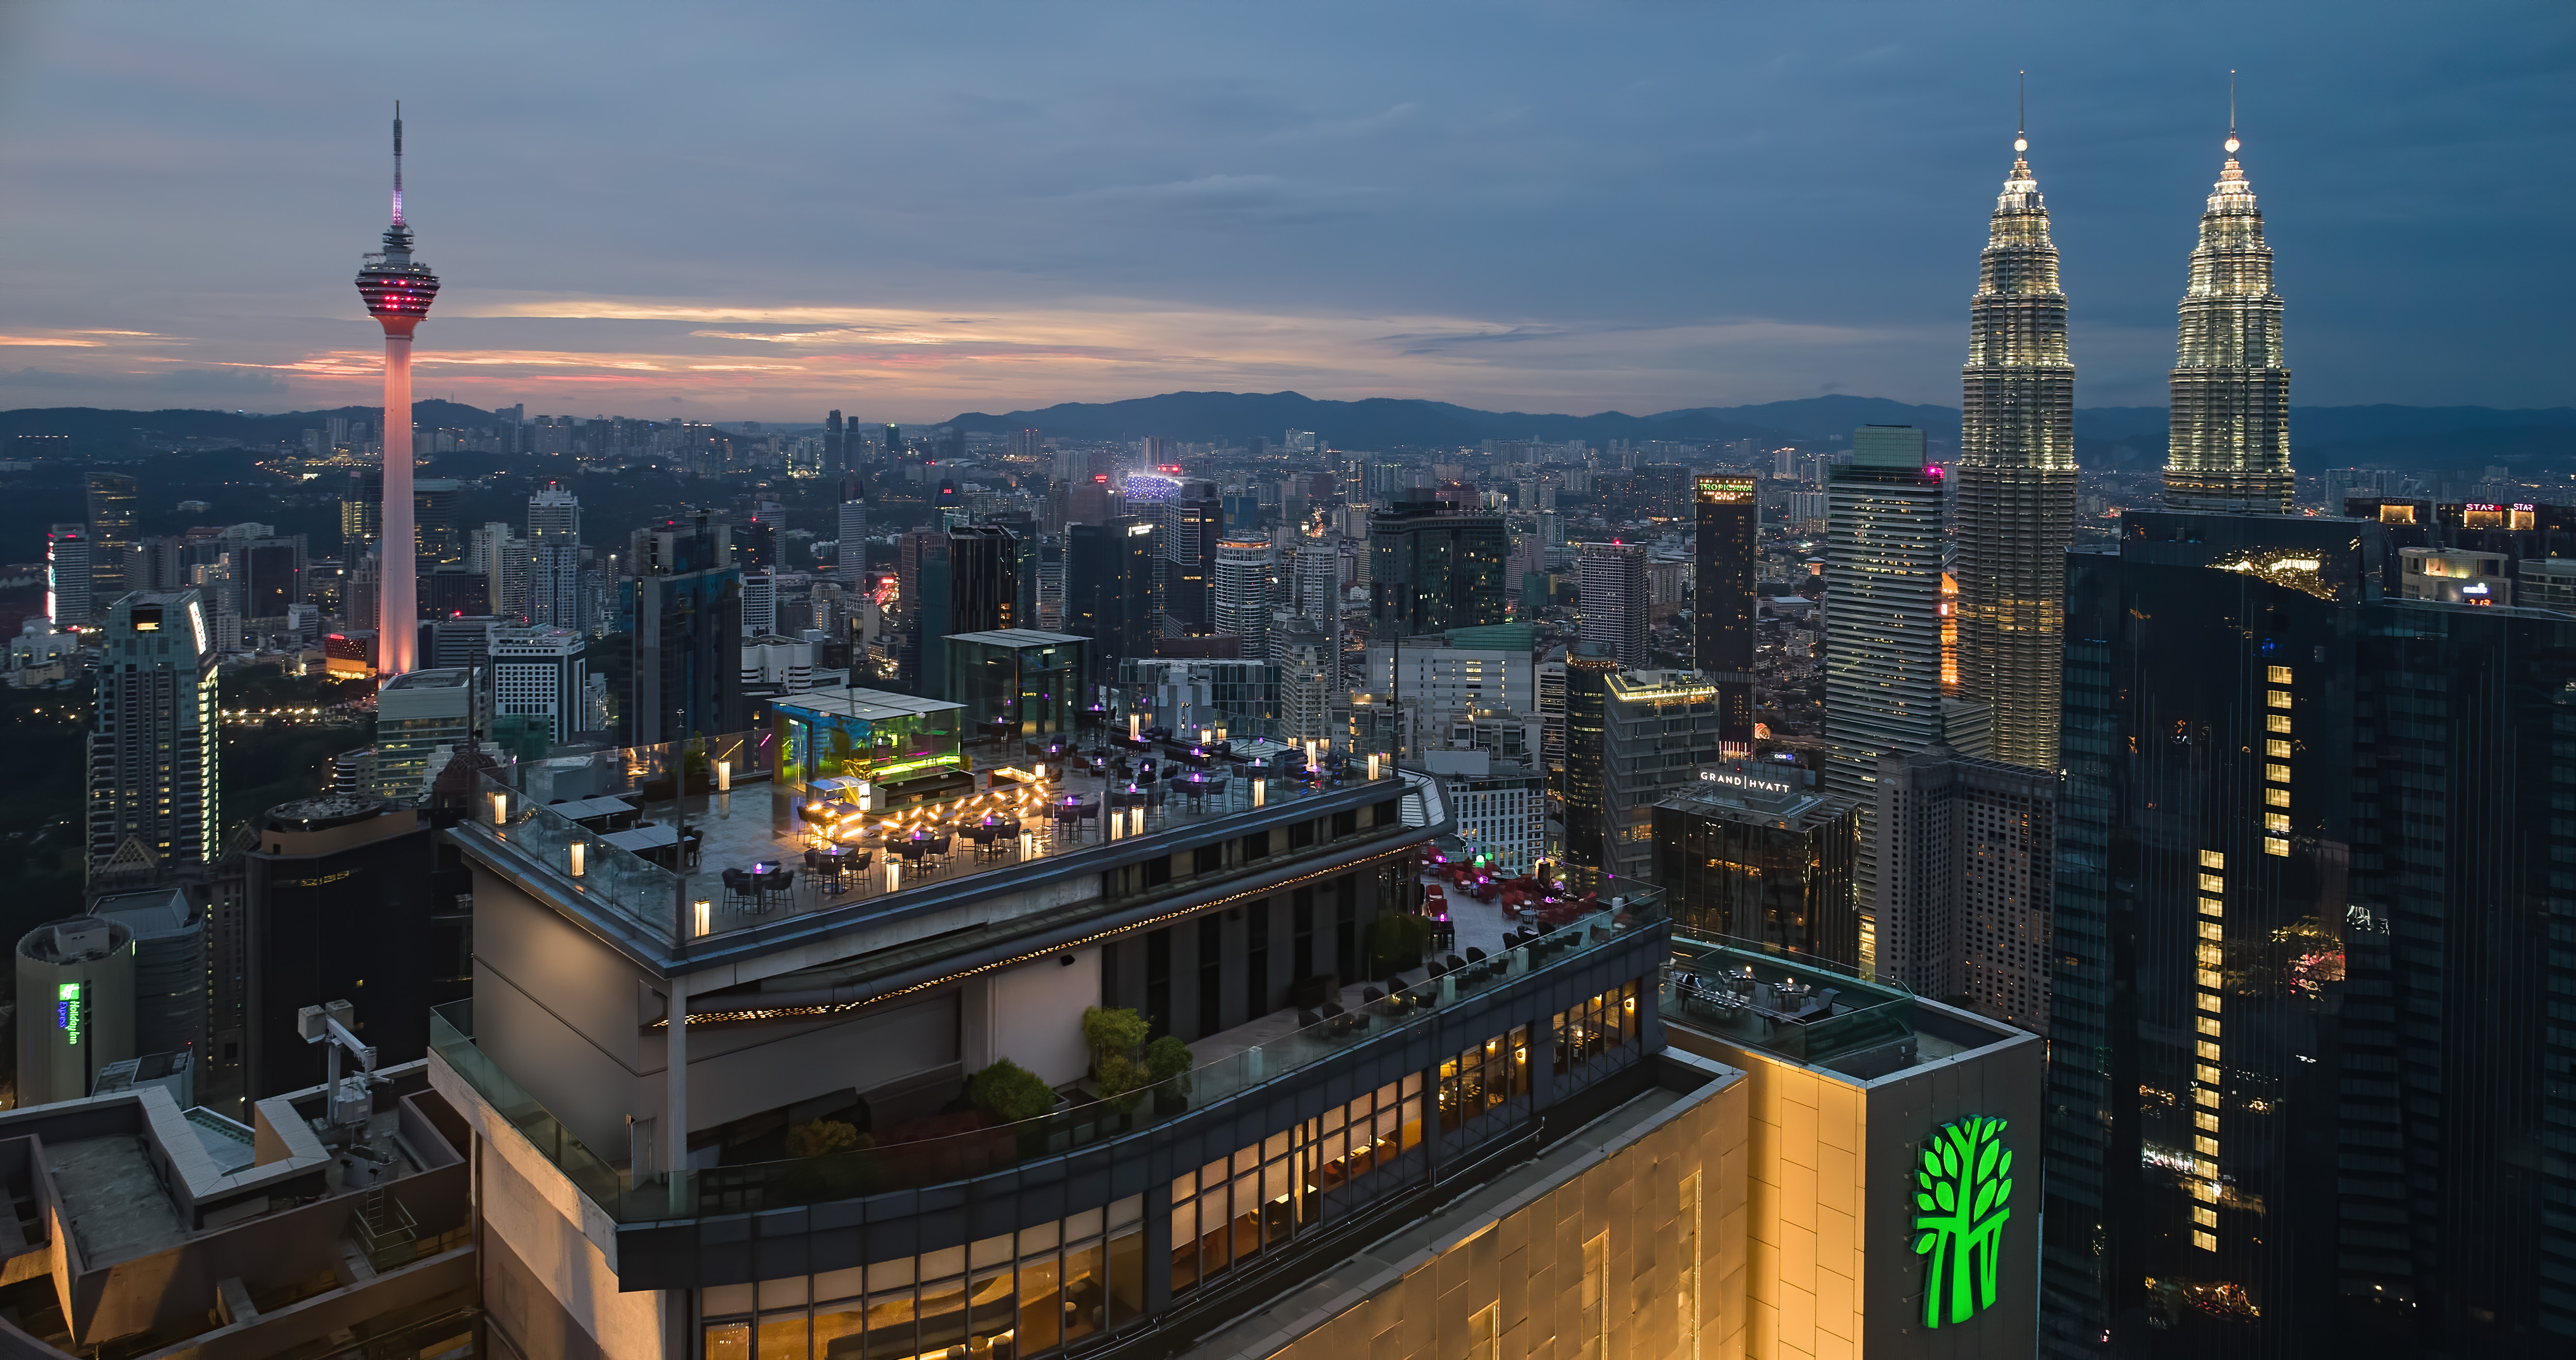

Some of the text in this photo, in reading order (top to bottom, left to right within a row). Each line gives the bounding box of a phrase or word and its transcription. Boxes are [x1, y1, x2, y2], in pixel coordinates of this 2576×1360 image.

[1699, 483, 1753, 492] TROPICANA
[2513, 503, 2534, 511] STAR
[1700, 771, 1790, 794] GRAND HYATT
[65, 1001, 80, 1045] Holiday Inn
